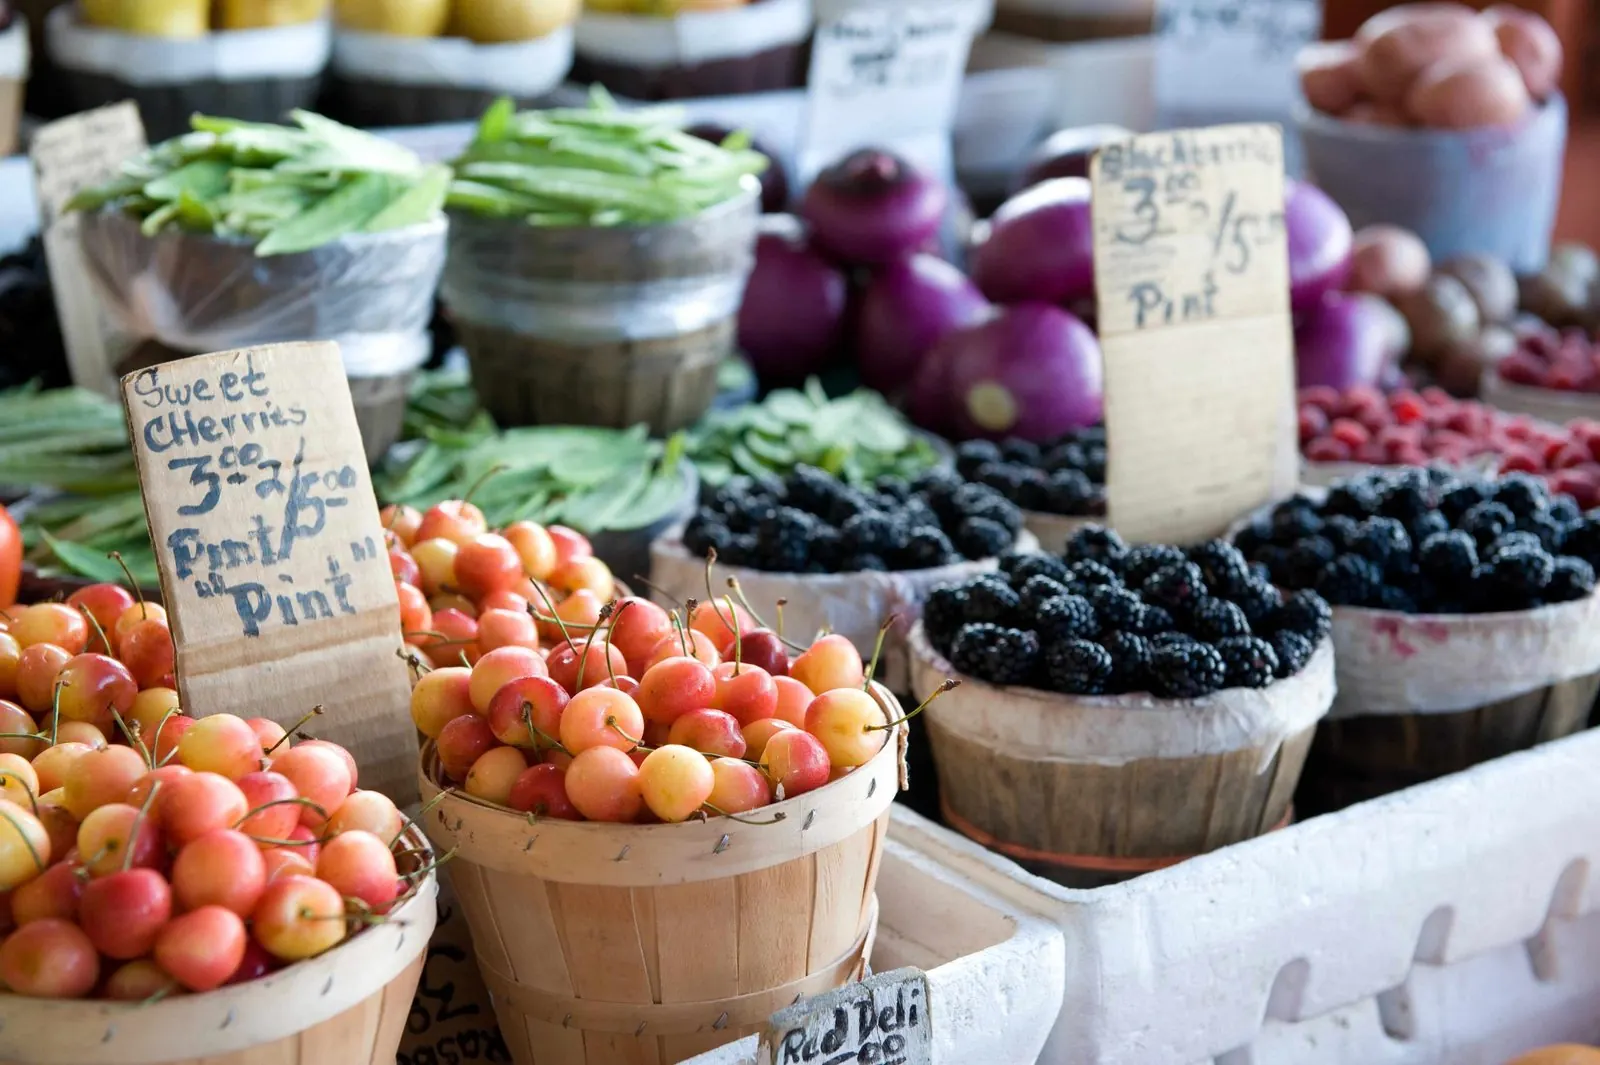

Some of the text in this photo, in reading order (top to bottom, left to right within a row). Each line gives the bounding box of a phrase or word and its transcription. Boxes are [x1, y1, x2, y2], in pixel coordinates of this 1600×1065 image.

[1129, 270, 1218, 329] Pint
[134, 353, 269, 408] Sweet
[784, 987, 920, 1065] Red Deli
